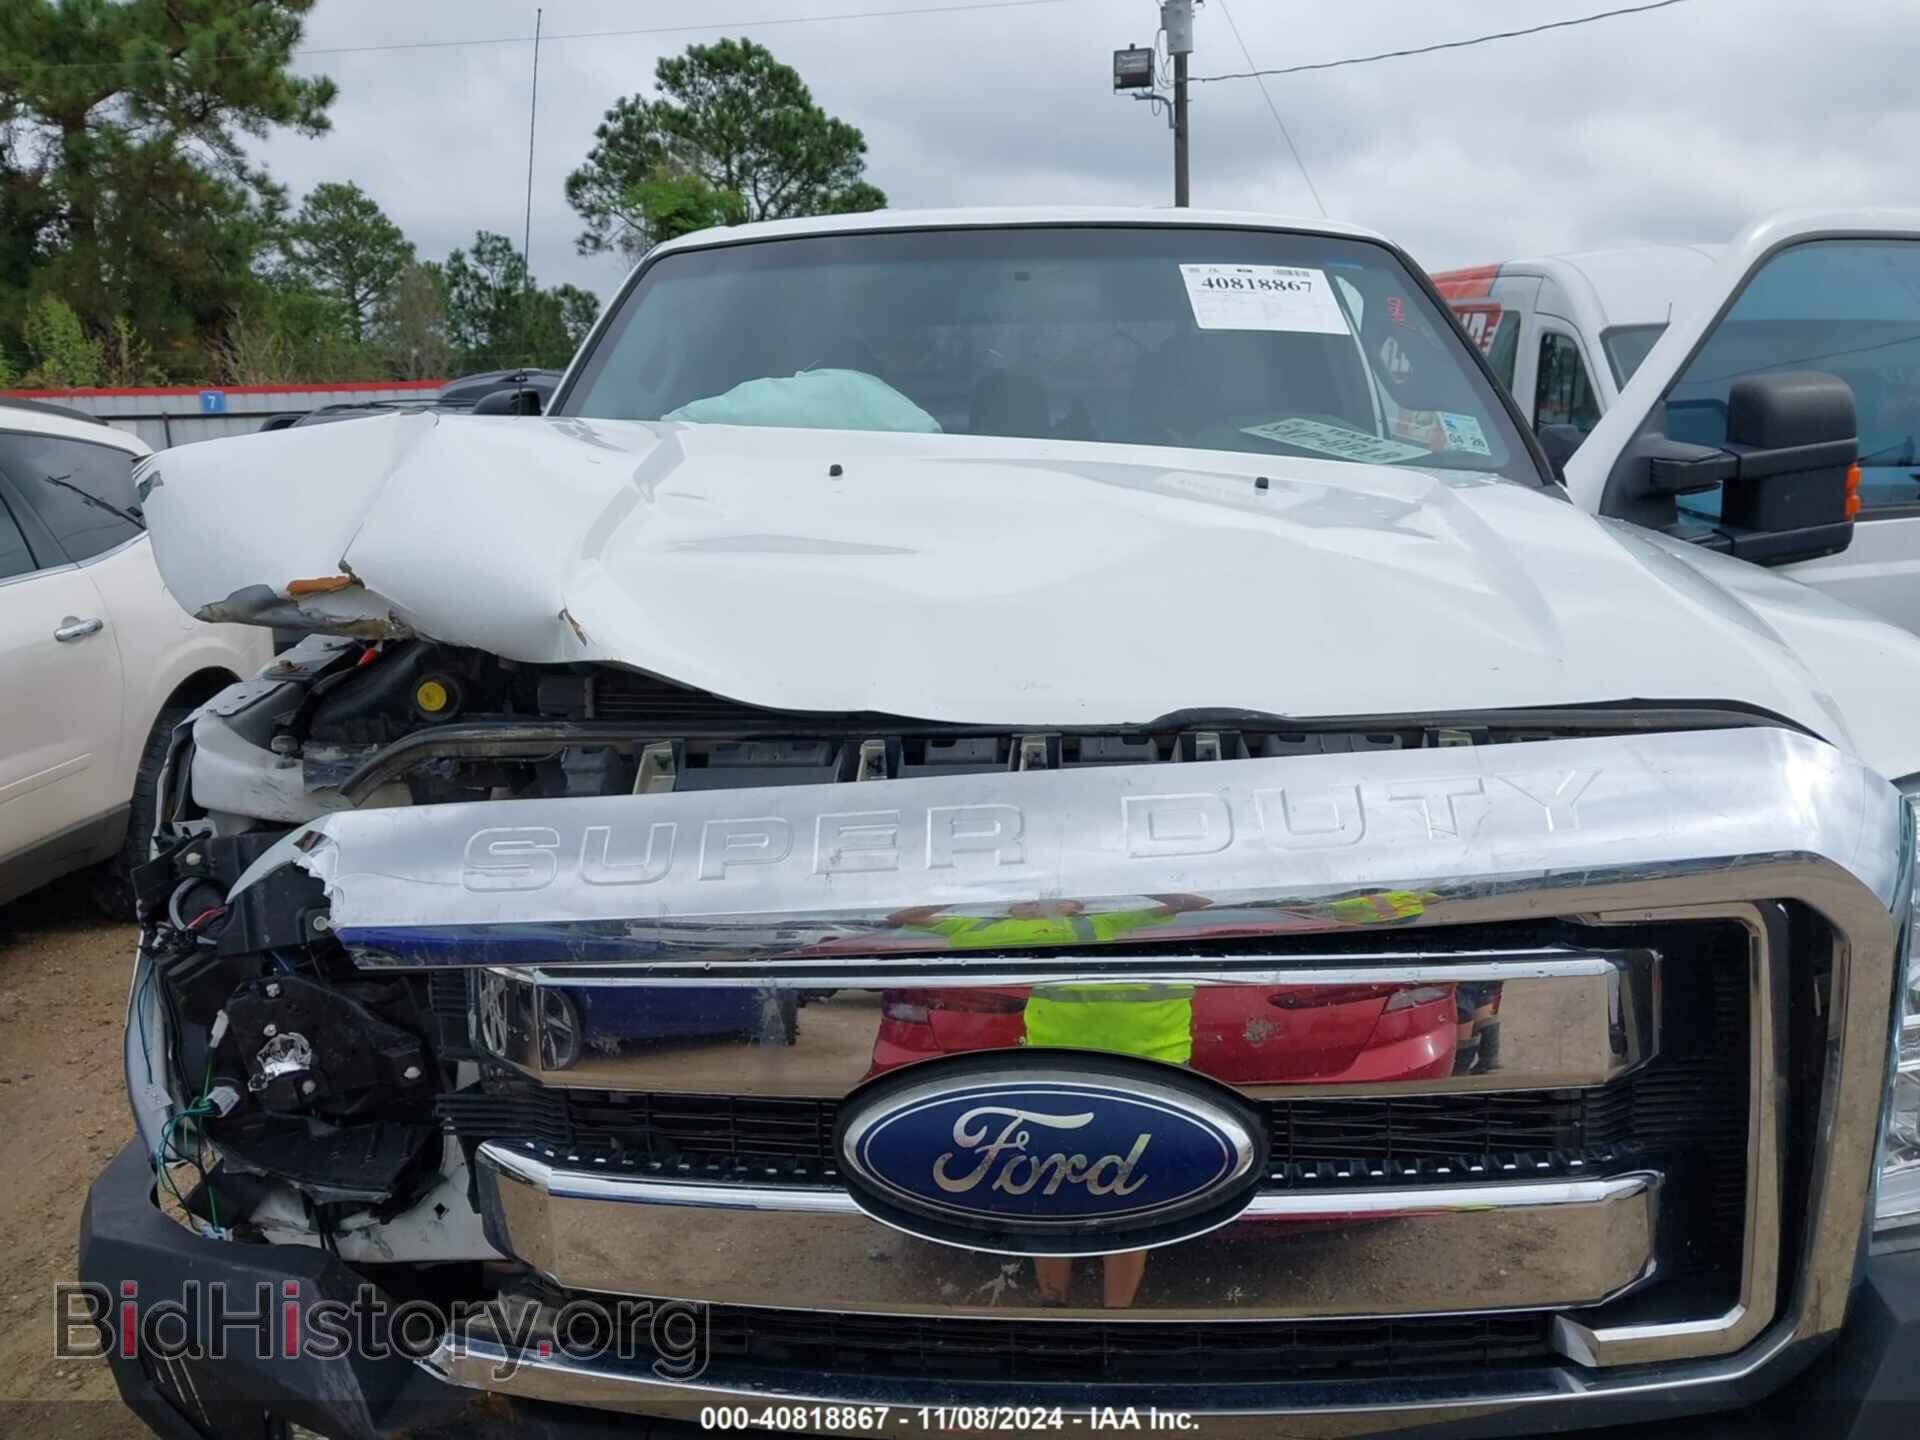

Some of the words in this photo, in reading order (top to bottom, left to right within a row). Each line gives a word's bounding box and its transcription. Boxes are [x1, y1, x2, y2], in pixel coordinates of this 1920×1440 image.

[1201, 276, 1312, 293] 40818867
[207, 394, 216, 409] 7
[463, 804, 1025, 892] SUPER
[1121, 768, 1601, 859] DUTY
[932, 1106, 1152, 1196] Ford
